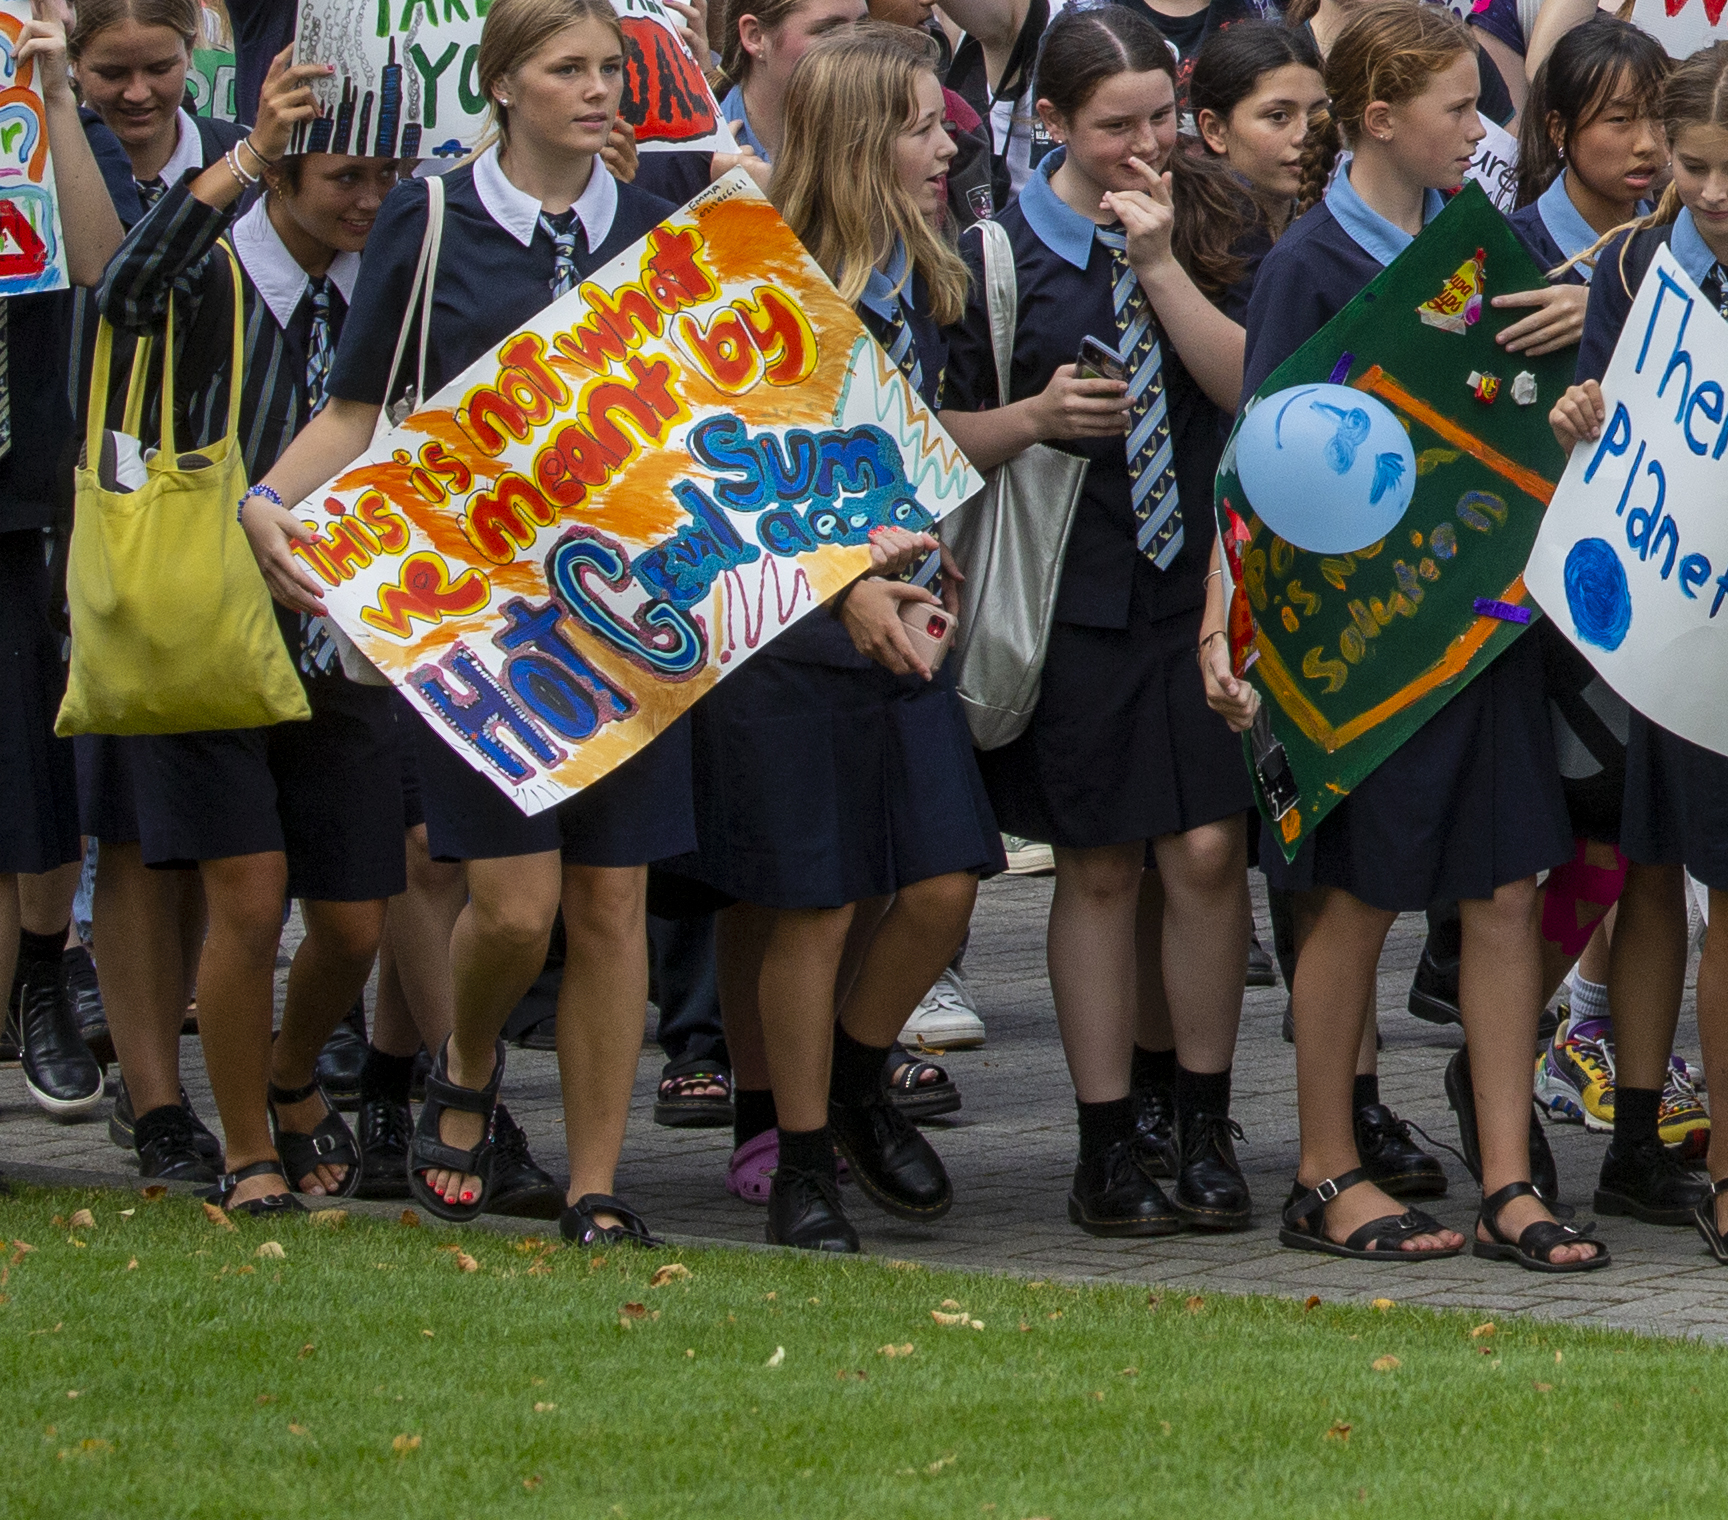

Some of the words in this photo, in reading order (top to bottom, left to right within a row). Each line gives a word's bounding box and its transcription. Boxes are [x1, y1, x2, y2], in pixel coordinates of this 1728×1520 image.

[687, 184, 721, 212] EMMA
[361, 550, 492, 639] we
[457, 353, 693, 565] meant
[669, 285, 820, 396] by
[392, 438, 475, 505] is
